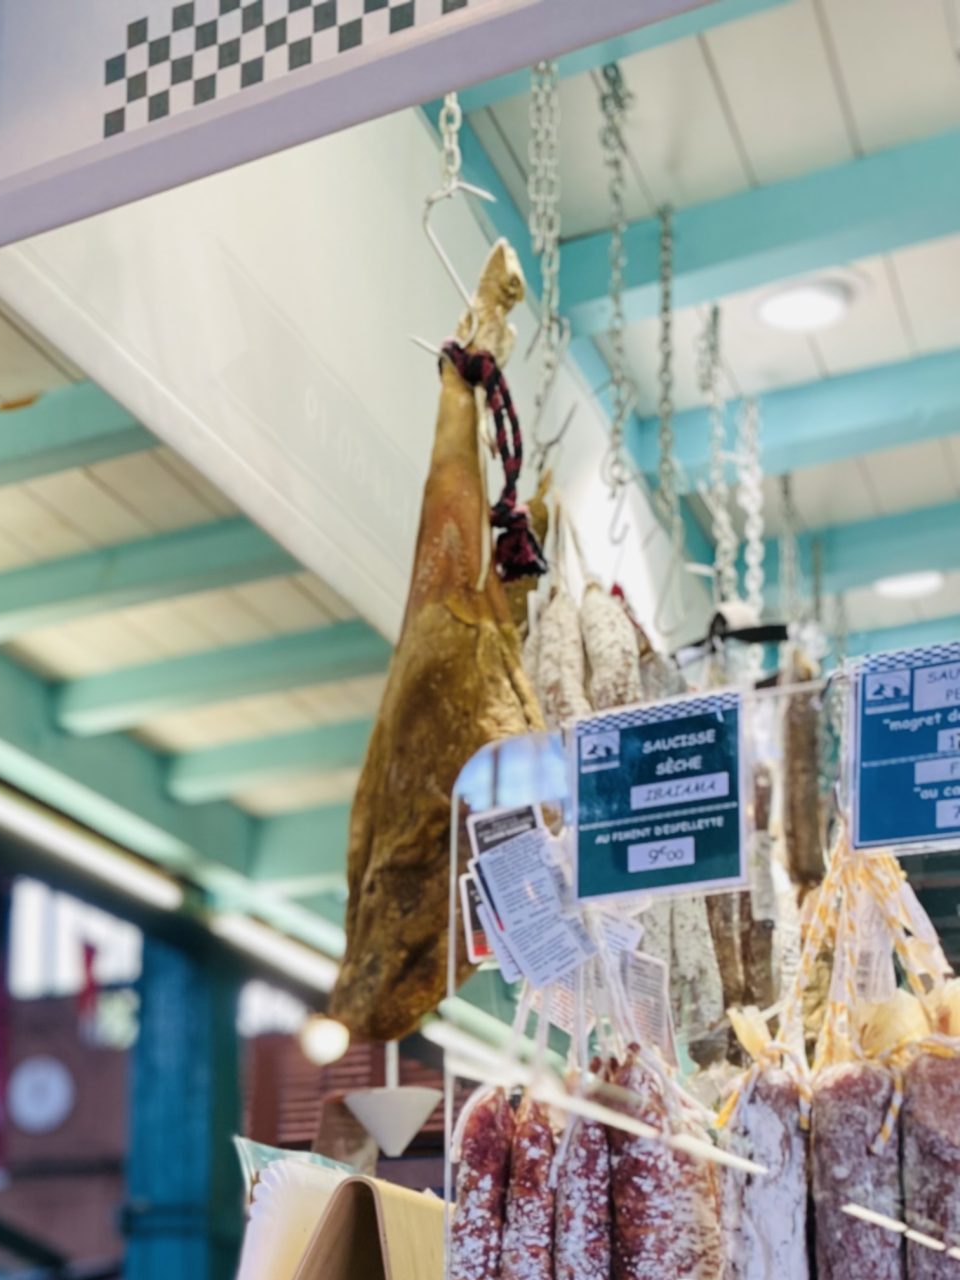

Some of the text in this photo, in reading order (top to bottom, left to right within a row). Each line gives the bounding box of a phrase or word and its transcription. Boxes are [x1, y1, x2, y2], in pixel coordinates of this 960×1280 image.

[643, 729, 716, 753] SAUCISSE
[656, 756, 703, 775] SÈCHE
[595, 833, 611, 844] AU
[612, 827, 652, 843] PIMENT
